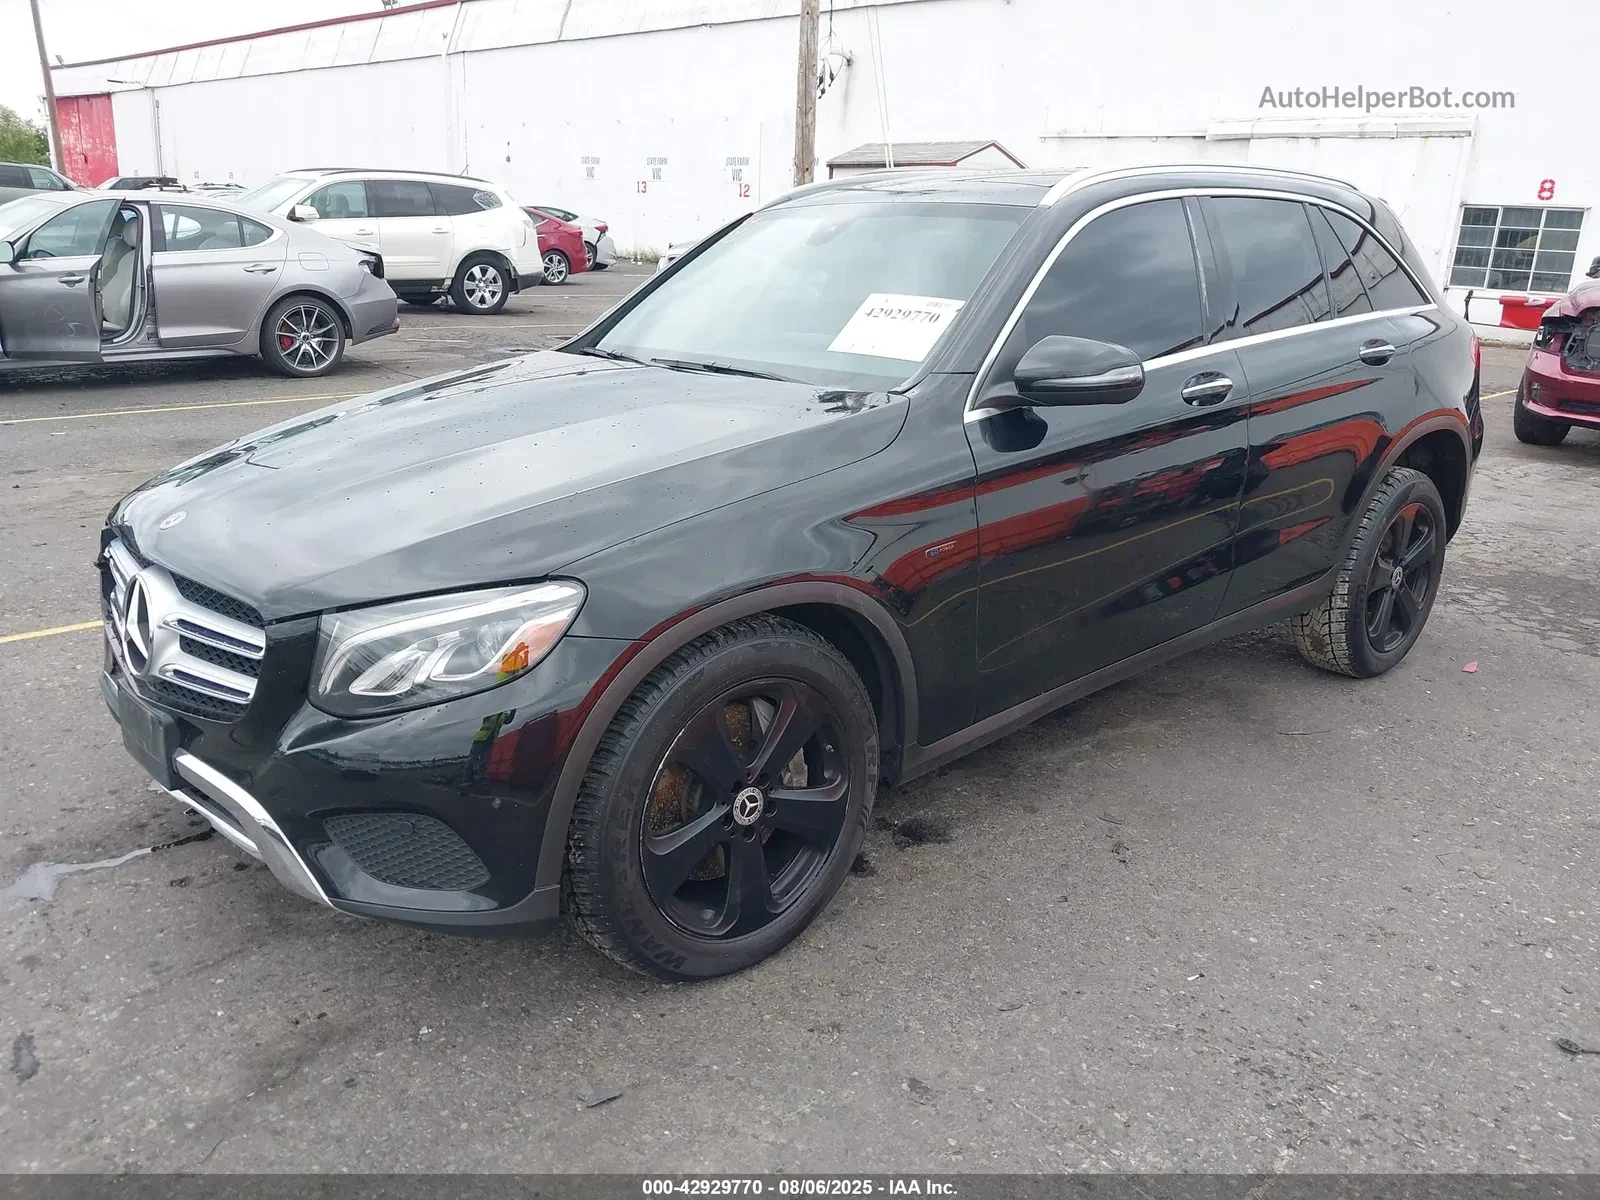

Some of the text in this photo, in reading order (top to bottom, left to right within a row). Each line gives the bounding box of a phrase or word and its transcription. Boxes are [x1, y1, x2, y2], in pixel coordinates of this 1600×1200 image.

[731, 168, 743, 182] VIC
[637, 180, 647, 194] 13
[739, 183, 750, 198] 12
[1537, 178, 1556, 201] 8
[864, 307, 941, 323] 42929770
